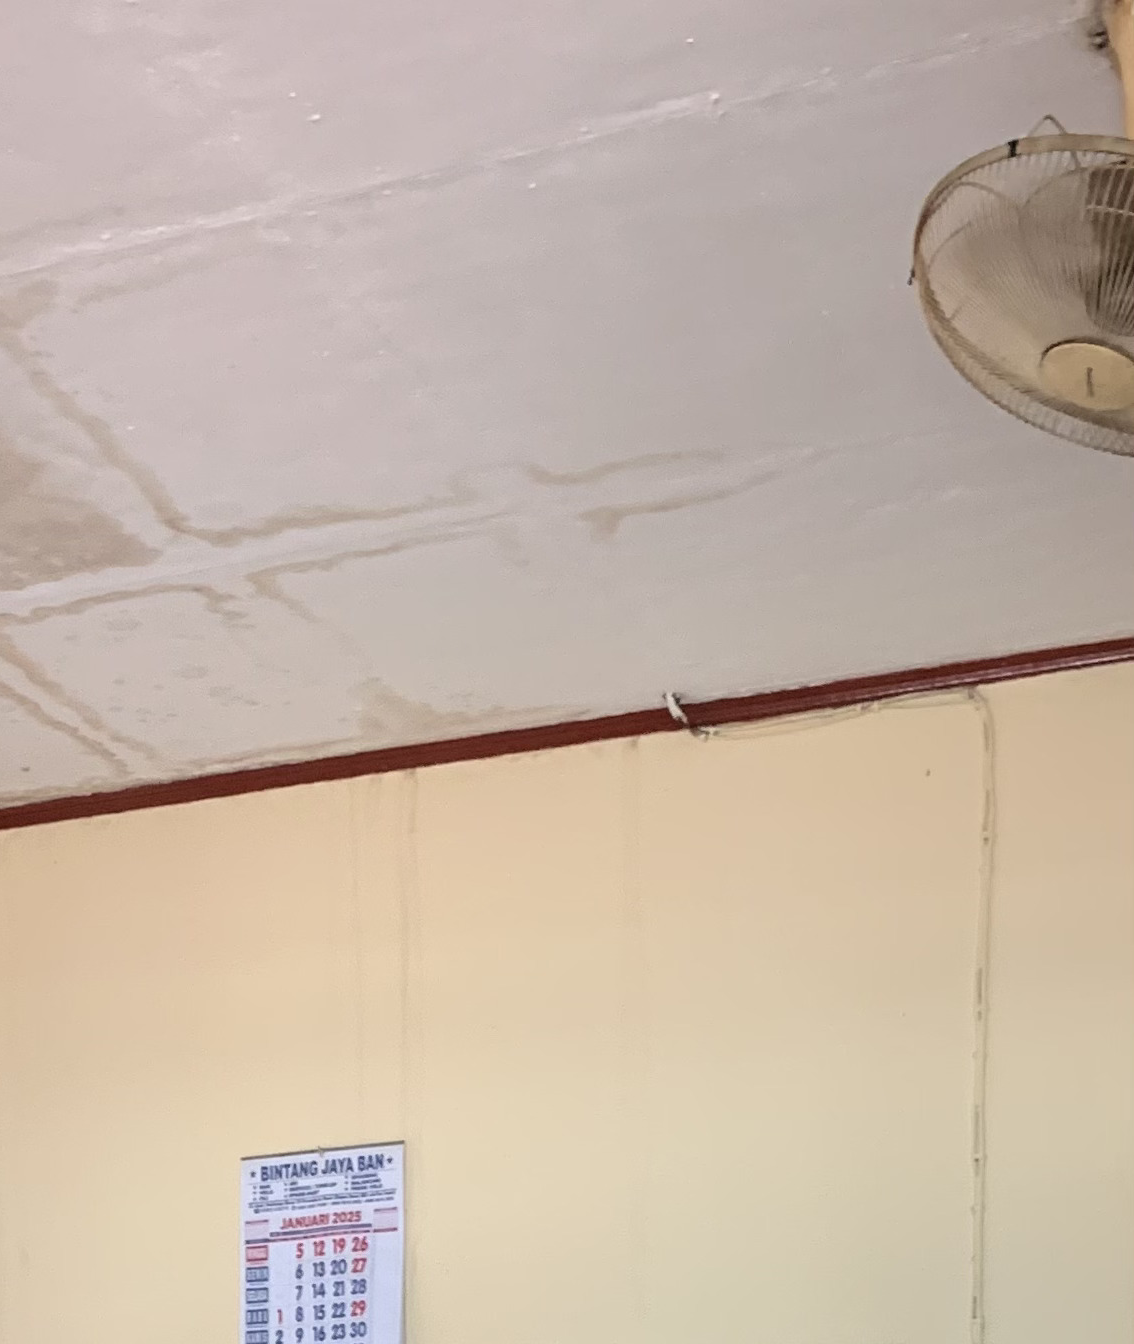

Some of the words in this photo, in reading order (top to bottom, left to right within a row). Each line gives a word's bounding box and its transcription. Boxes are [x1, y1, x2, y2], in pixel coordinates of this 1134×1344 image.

[261, 1160, 318, 1181] BINTANG
[321, 1157, 354, 1174] JAYA
[357, 1154, 384, 1171] BAN
[281, 1213, 330, 1229] JANUARI
[332, 1211, 362, 1223] 2025
[296, 1243, 304, 1259] 5
[313, 1241, 326, 1257] 12
[332, 1238, 346, 1254] 19
[351, 1236, 368, 1252] 26
[295, 1264, 304, 1279] 6
[313, 1262, 326, 1277] 13
[330, 1259, 347, 1275] 20
[351, 1258, 367, 1273] 27
[295, 1285, 303, 1301] 7
[312, 1283, 326, 1298] 14
[333, 1281, 345, 1297] 21
[350, 1279, 366, 1295] 28
[277, 1309, 284, 1324] 1
[295, 1306, 304, 1322] 8
[313, 1305, 326, 1320] 15
[331, 1302, 346, 1318] 22
[350, 1300, 366, 1316] 29
[275, 1330, 284, 1344] 2
[295, 1328, 304, 1343] 9
[312, 1326, 326, 1341] 16
[331, 1324, 346, 1340] 23
[349, 1322, 366, 1338] 30
